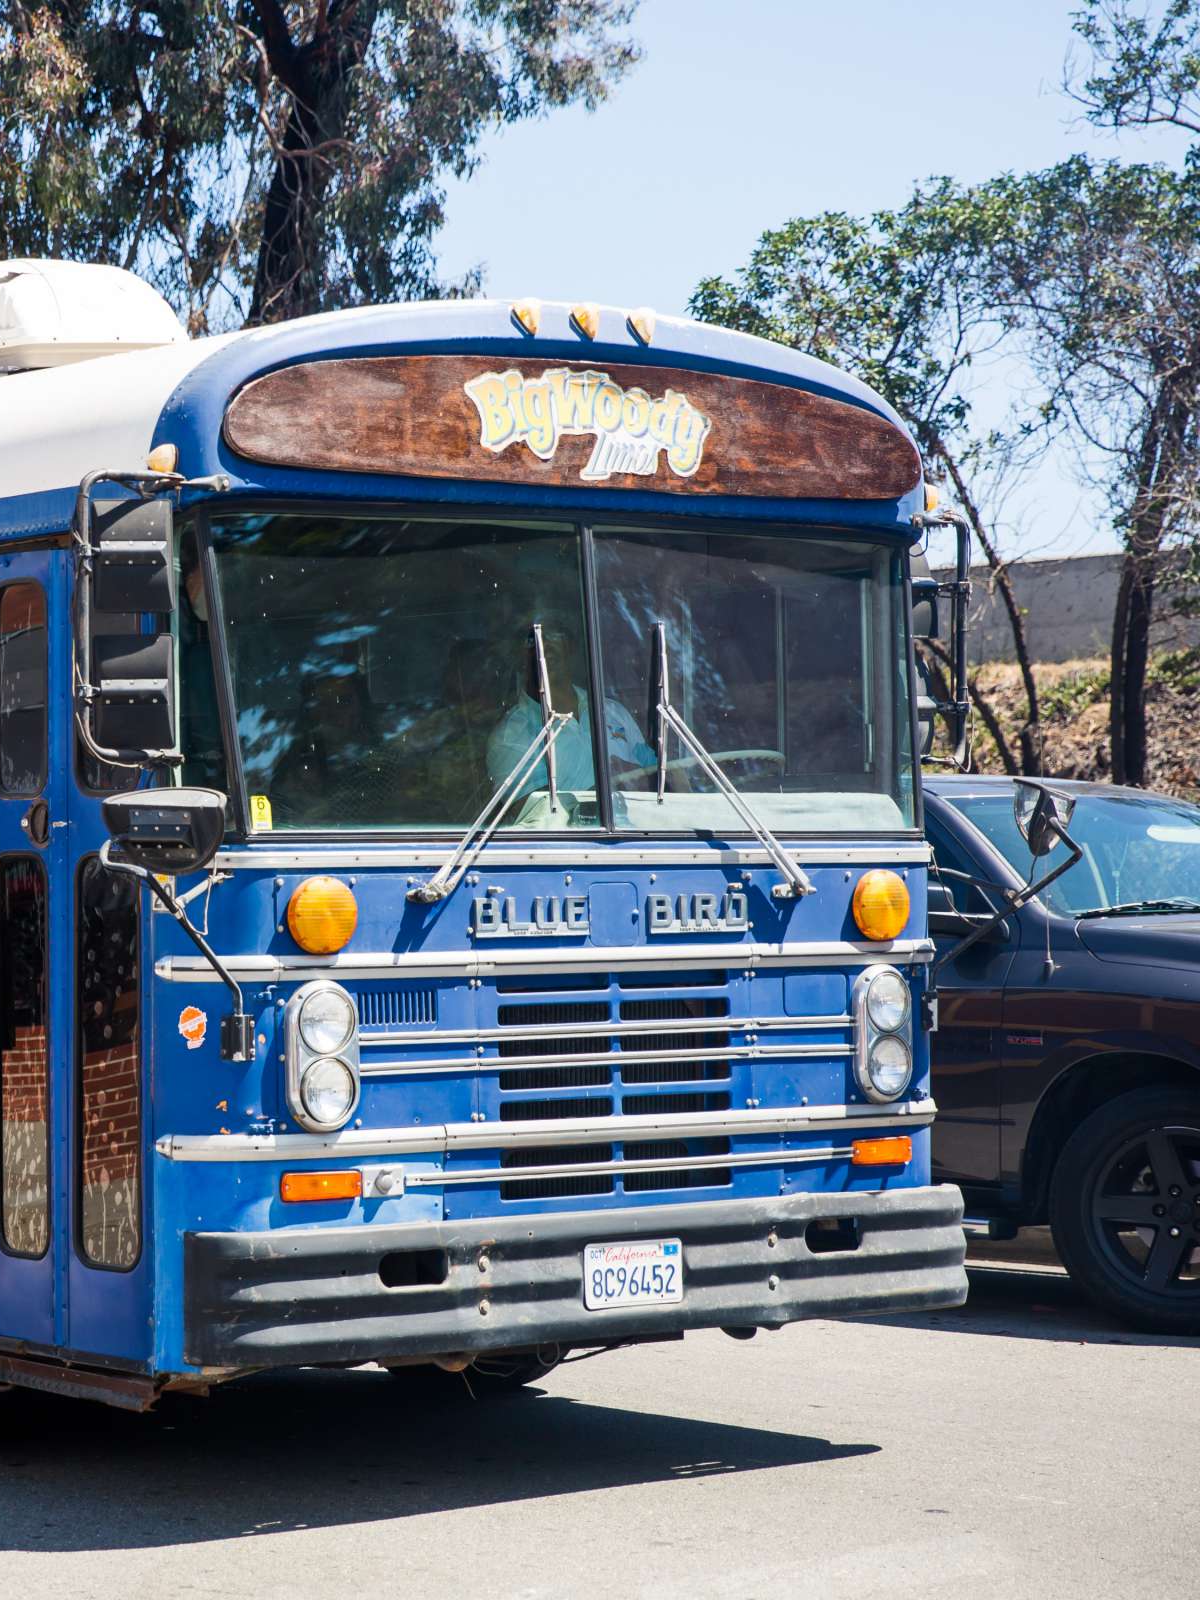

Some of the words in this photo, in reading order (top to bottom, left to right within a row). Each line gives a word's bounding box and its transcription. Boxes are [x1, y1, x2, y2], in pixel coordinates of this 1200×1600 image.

[475, 896, 589, 932] BLUE
[650, 893, 747, 928] BIRD
[604, 1247, 657, 1264] California
[592, 1264, 676, 1298] 8C96452
